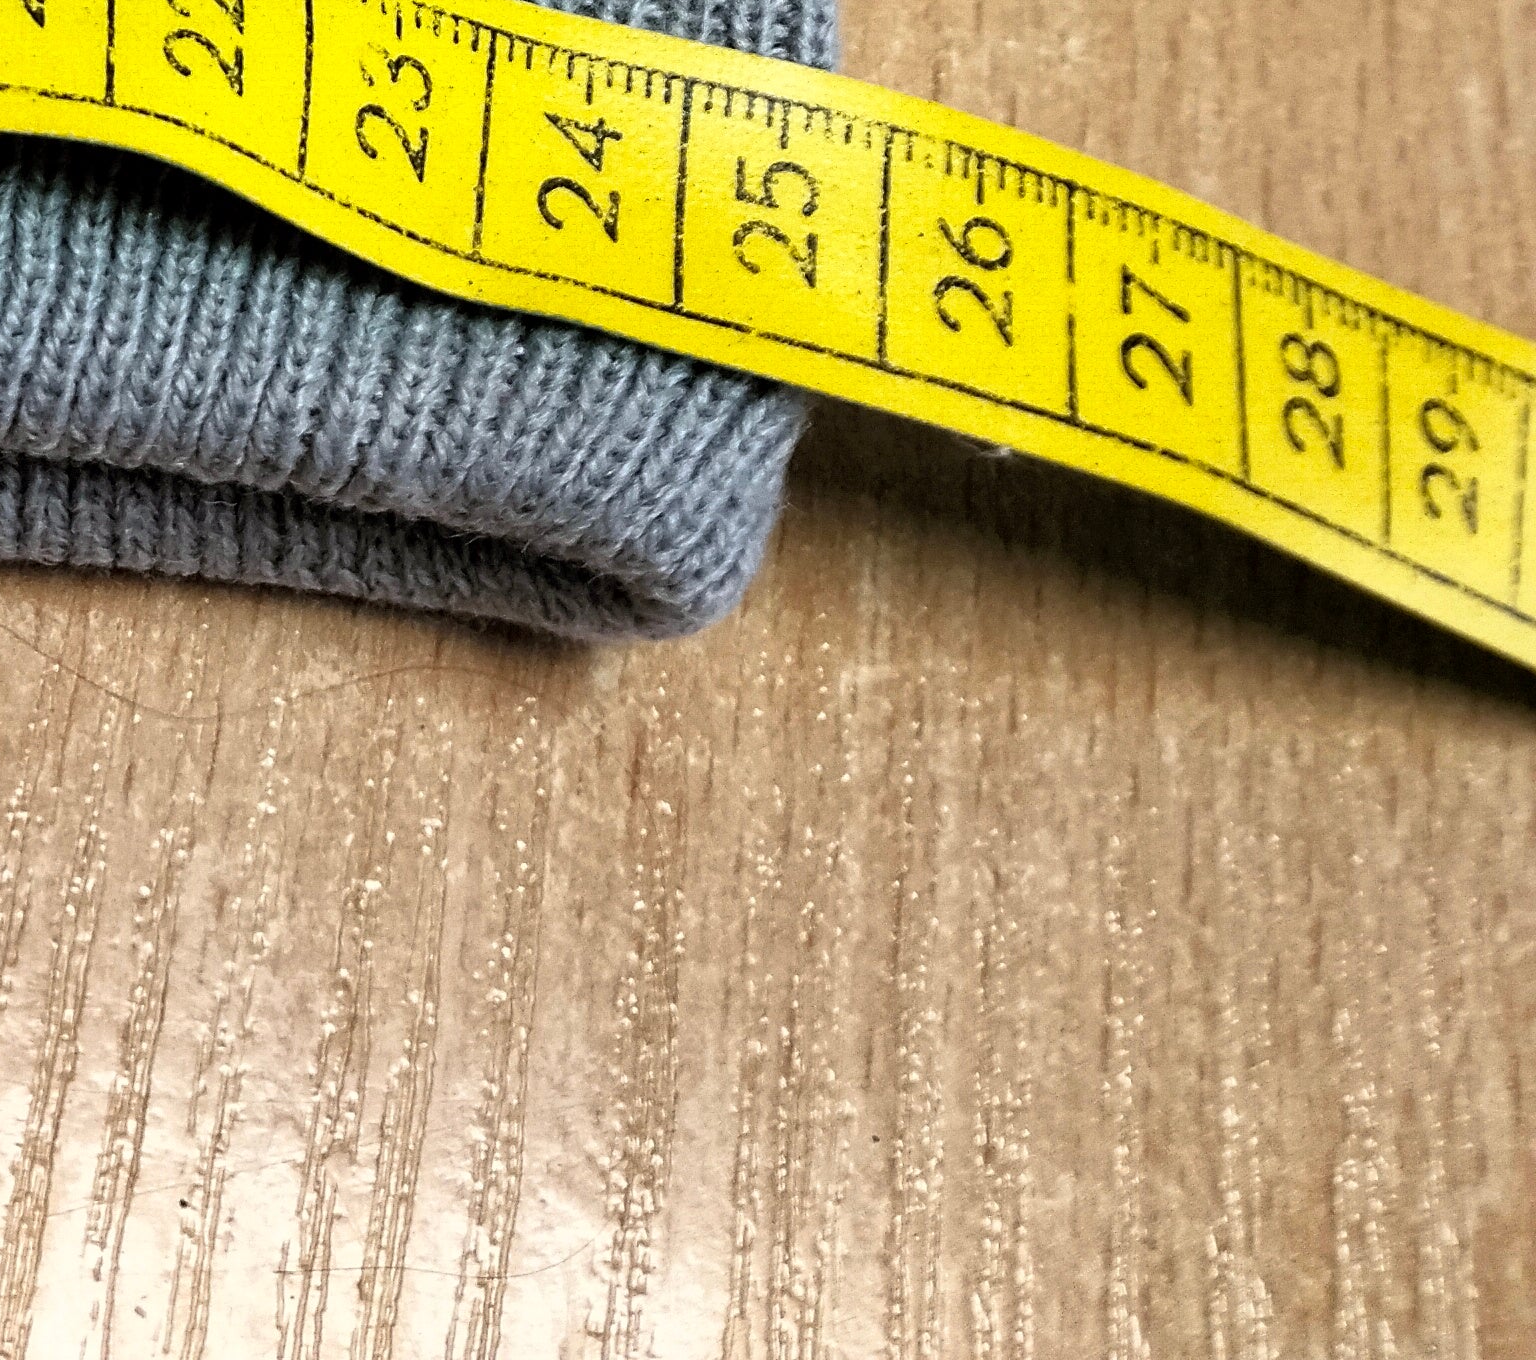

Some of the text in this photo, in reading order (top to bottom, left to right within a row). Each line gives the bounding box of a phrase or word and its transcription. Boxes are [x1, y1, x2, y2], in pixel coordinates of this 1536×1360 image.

[355, 37, 433, 183] 23
[536, 112, 623, 243] 24
[732, 156, 821, 290] 25
[932, 216, 1013, 348] 26
[1120, 263, 1195, 407] 27
[1279, 332, 1347, 471] 28
[1417, 396, 1481, 536] 29
